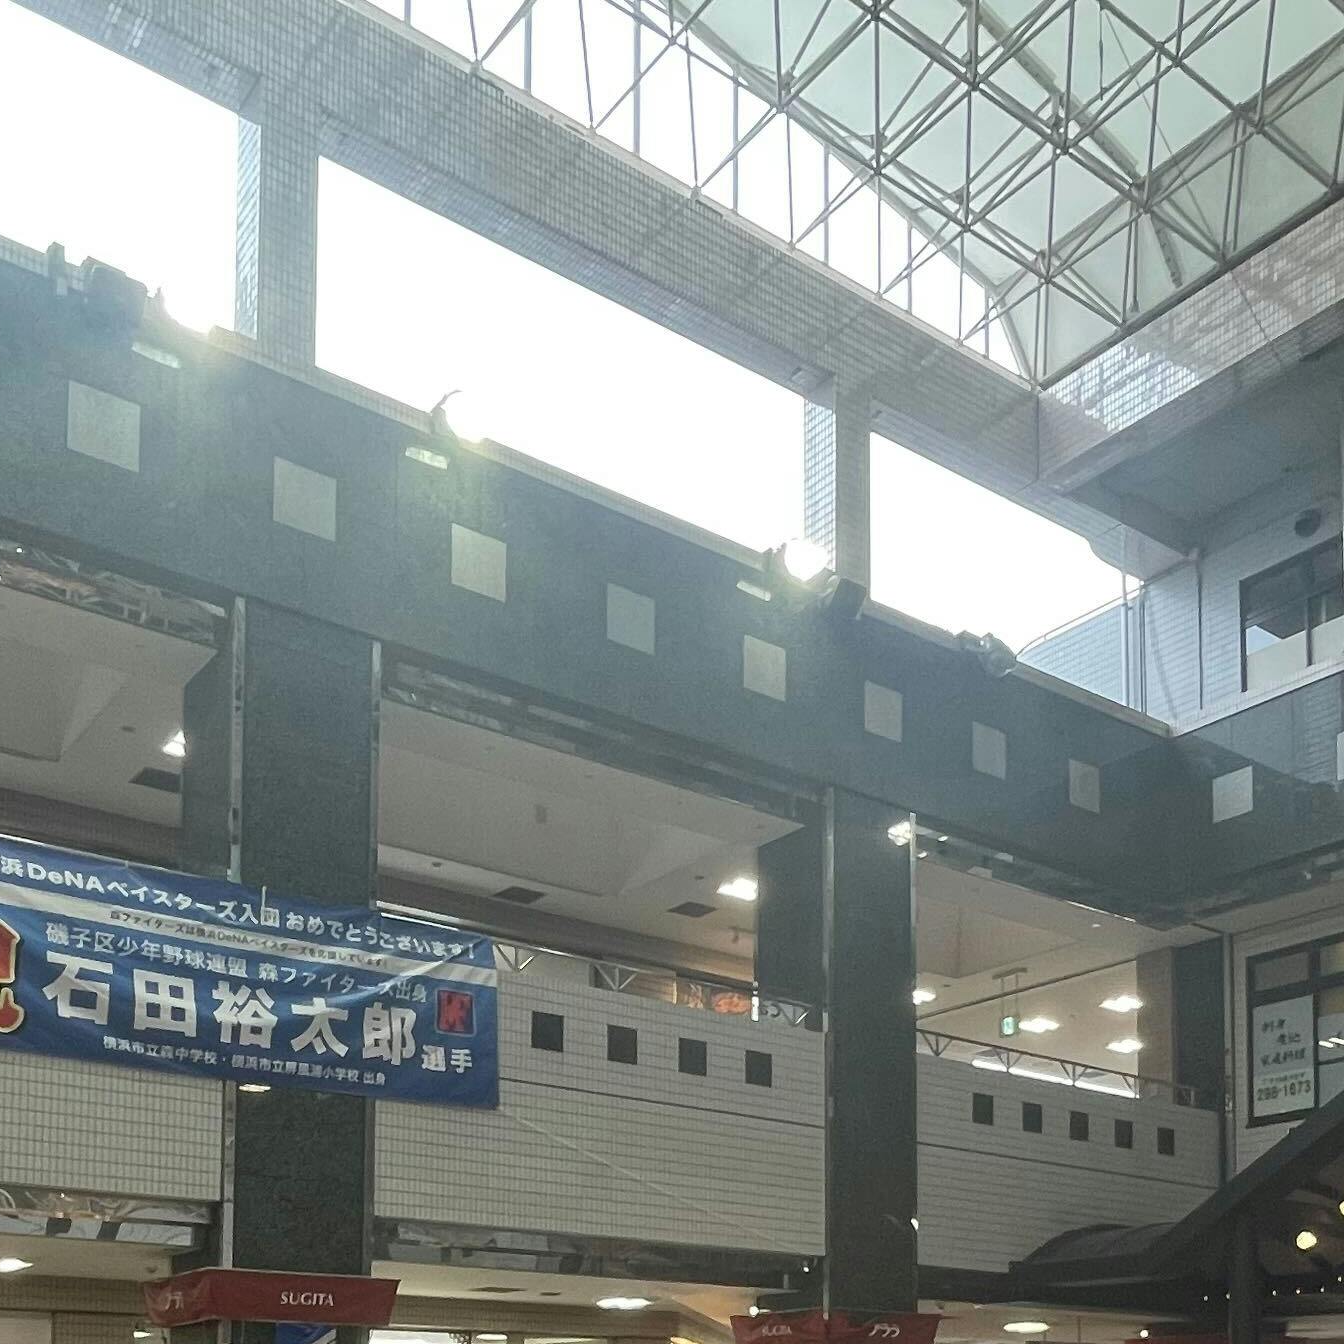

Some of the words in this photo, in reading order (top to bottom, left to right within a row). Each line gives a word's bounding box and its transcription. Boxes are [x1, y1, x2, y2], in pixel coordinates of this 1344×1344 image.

[45, 921, 248, 979] 磯子区少年野球連盟
[42, 949, 417, 1066] 石田裕太郎
[421, 1043, 474, 1074] 選手
[280, 1291, 334, 1307] SUGITA
